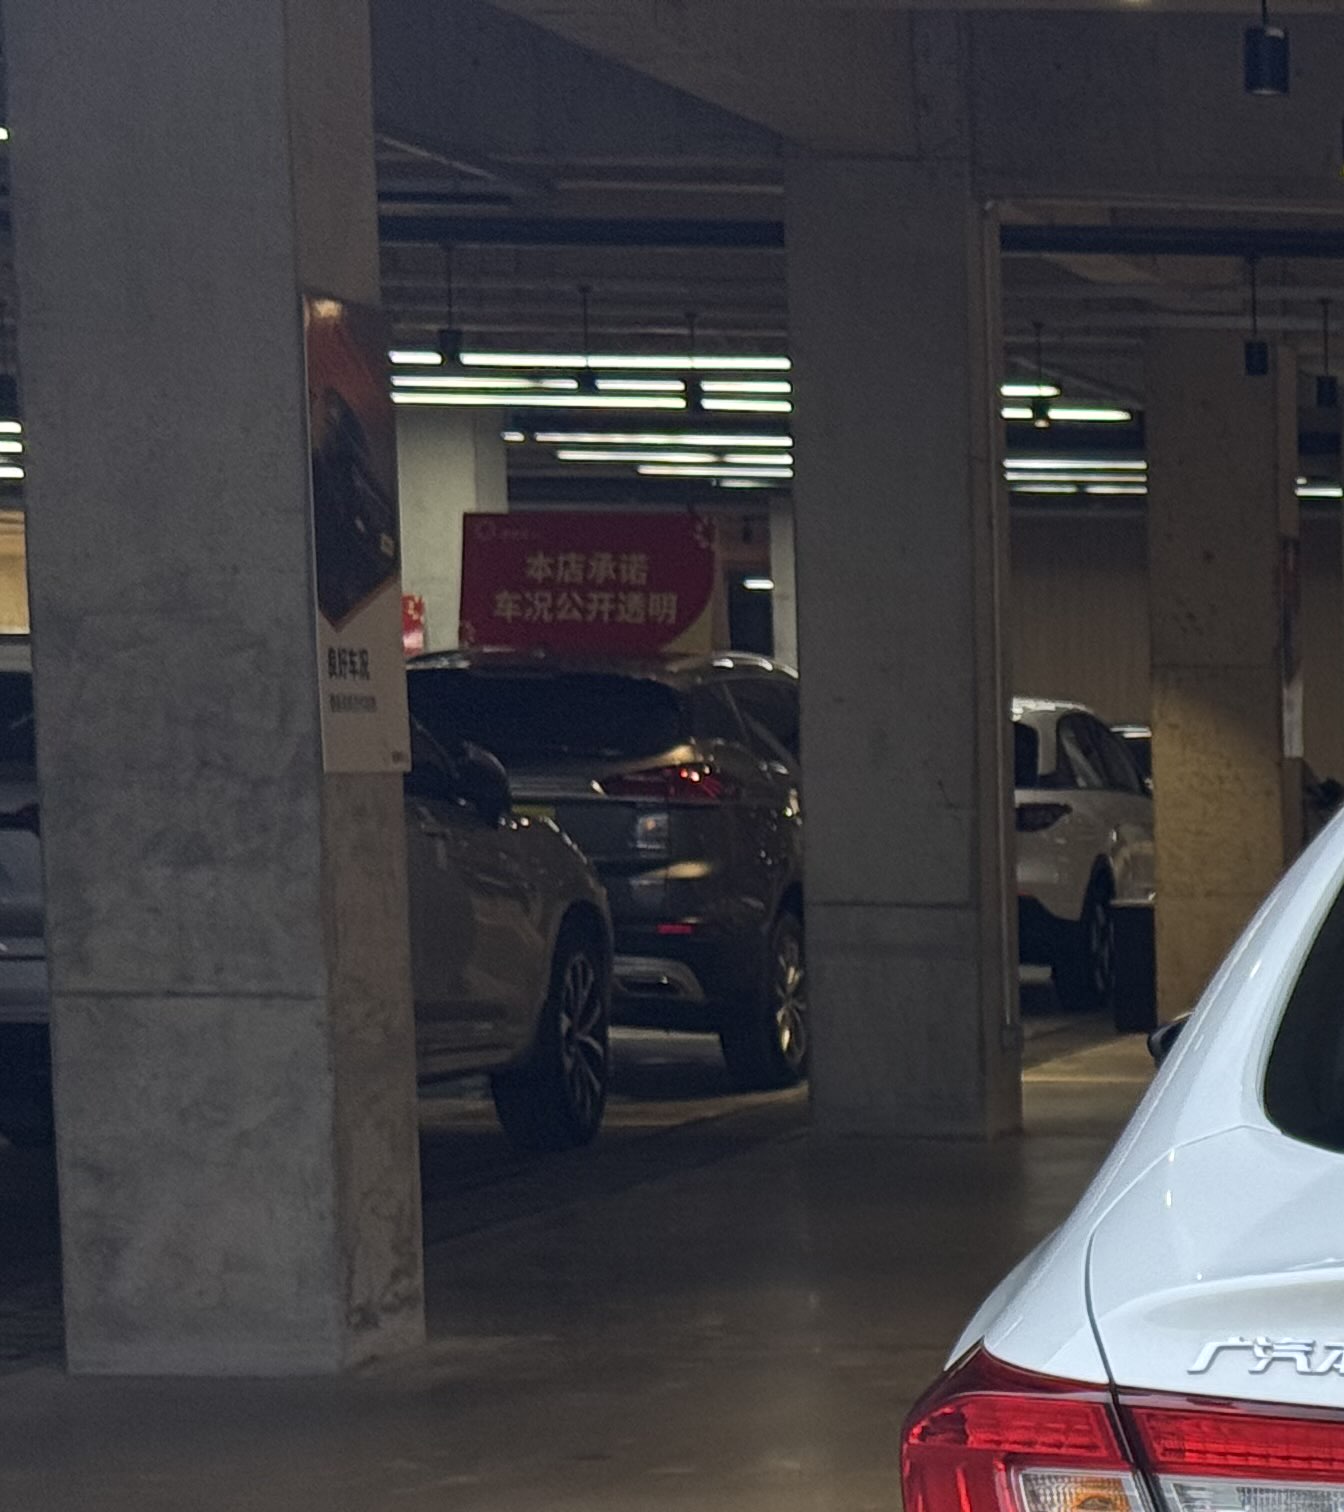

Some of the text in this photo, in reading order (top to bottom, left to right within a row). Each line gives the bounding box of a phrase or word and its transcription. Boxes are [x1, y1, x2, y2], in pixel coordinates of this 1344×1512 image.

[525, 552, 648, 585] 本店承诺
[495, 590, 678, 625] 车况公开透明
